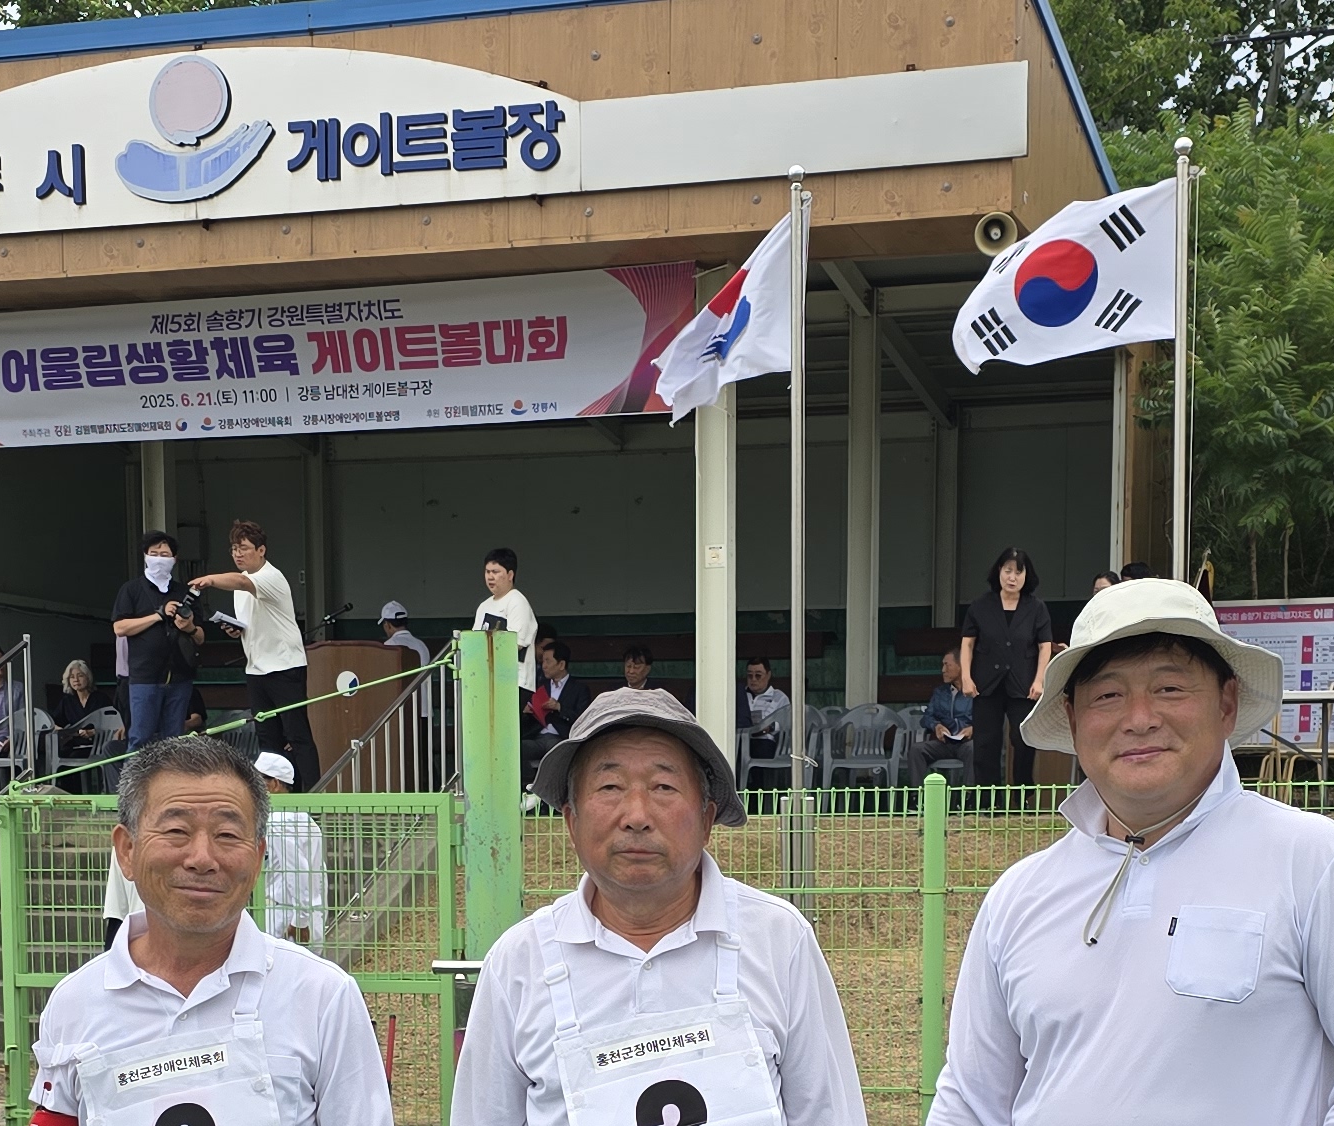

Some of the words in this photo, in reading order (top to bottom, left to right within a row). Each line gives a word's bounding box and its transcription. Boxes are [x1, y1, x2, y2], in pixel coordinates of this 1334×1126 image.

[286, 100, 566, 182] 게이트볼장
[149, 311, 201, 335] 제5회
[205, 307, 264, 333] 솔향기
[267, 298, 404, 329] 강원특별자치도
[1, 333, 300, 393] 어울림생활체육
[306, 315, 568, 375] 게이트볼대회
[139, 393, 179, 409] 2025.
[241, 388, 278, 404] 11:00
[297, 385, 321, 402] 강릉
[324, 383, 359, 400] 남대천
[362, 380, 433, 399] 게이트볼구장
[218, 415, 293, 430] 강릉시장애인체육회
[302, 409, 400, 426] 강릉시장애인게이트볼연맹
[531, 401, 558, 414] 강릉시
[596, 1028, 711, 1067] 홍천군장애인체육회
[117, 1050, 225, 1087] 홍천군장애인체육회
